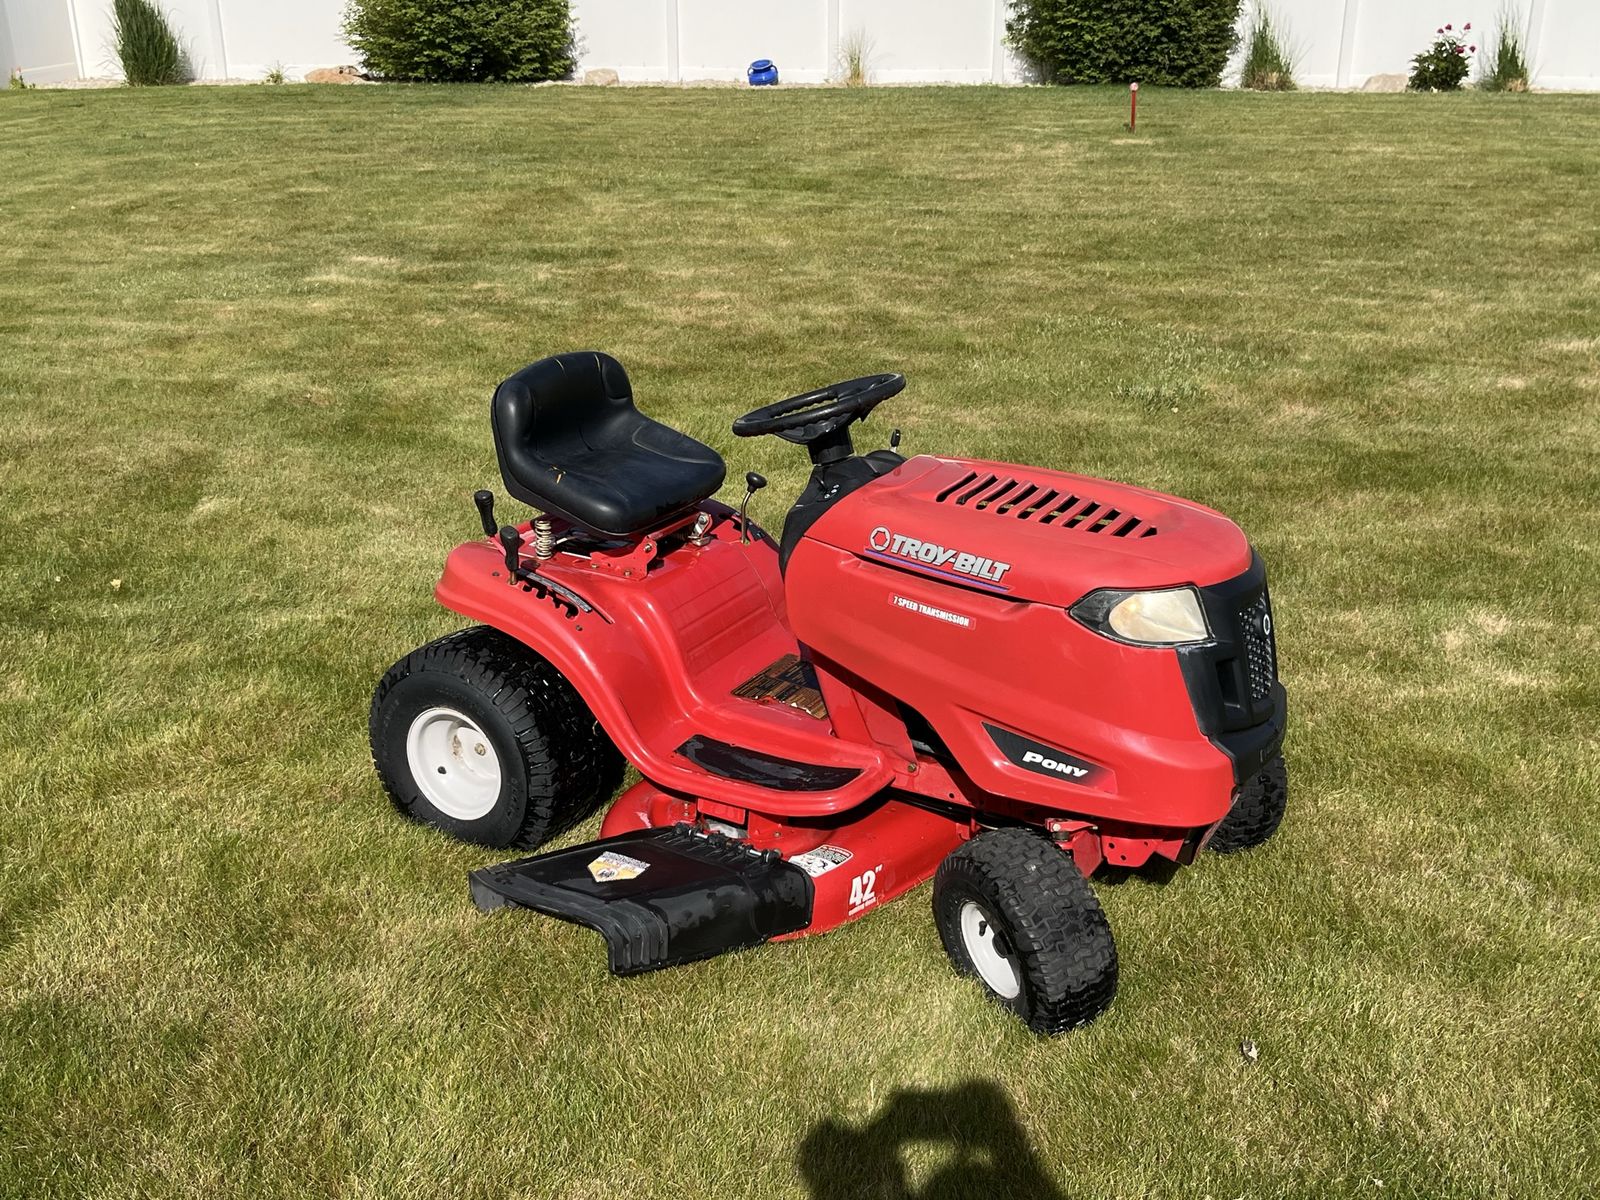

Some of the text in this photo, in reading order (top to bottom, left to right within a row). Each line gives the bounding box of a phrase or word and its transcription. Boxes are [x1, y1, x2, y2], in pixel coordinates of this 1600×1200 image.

[890, 533, 1011, 582] TROY-BILT
[898, 597, 918, 611] SPEED
[918, 604, 970, 627] TRANSMISSION
[1022, 751, 1089, 777] PONY
